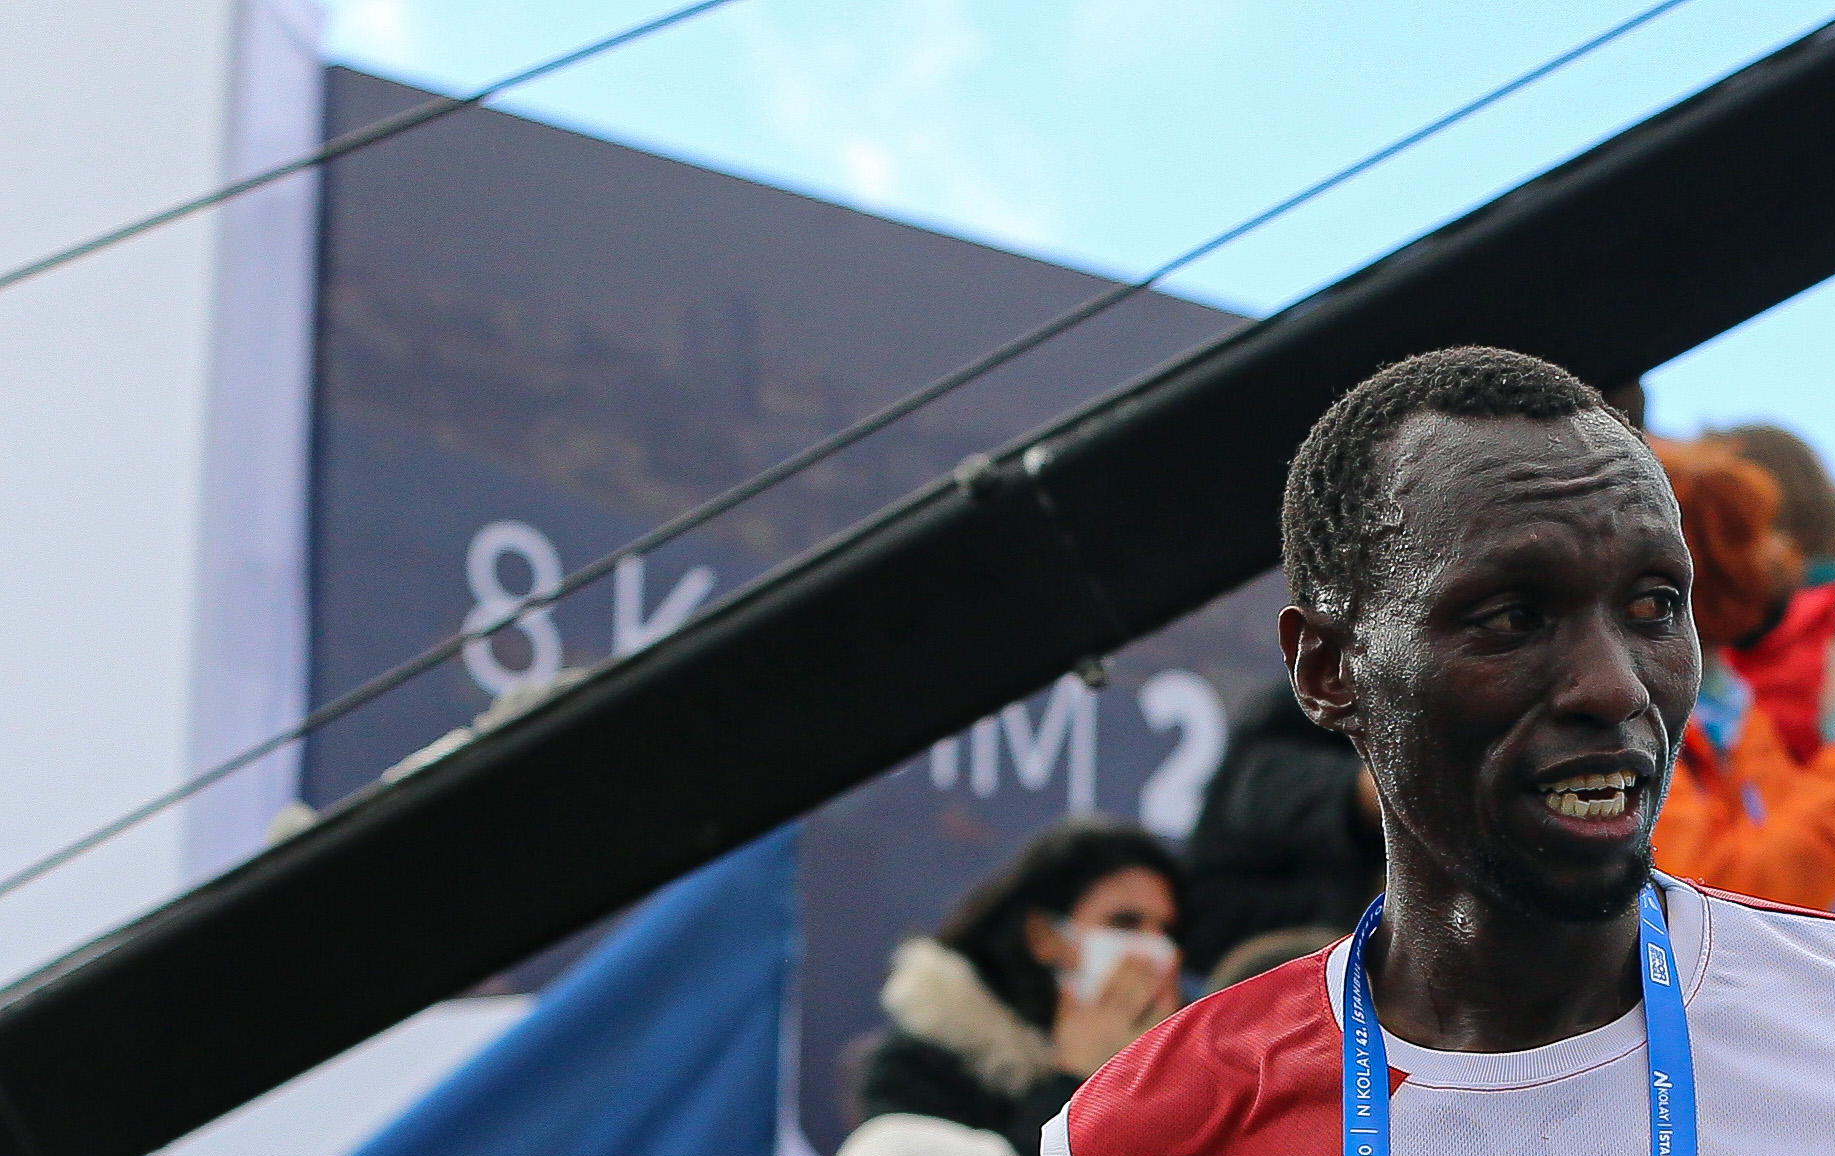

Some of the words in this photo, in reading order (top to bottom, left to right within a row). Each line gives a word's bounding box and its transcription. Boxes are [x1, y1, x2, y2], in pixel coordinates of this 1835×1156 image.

[461, 519, 564, 697] 8
[1355, 1047, 1371, 1099] KOLAY
[1357, 1105, 1371, 1117] N
